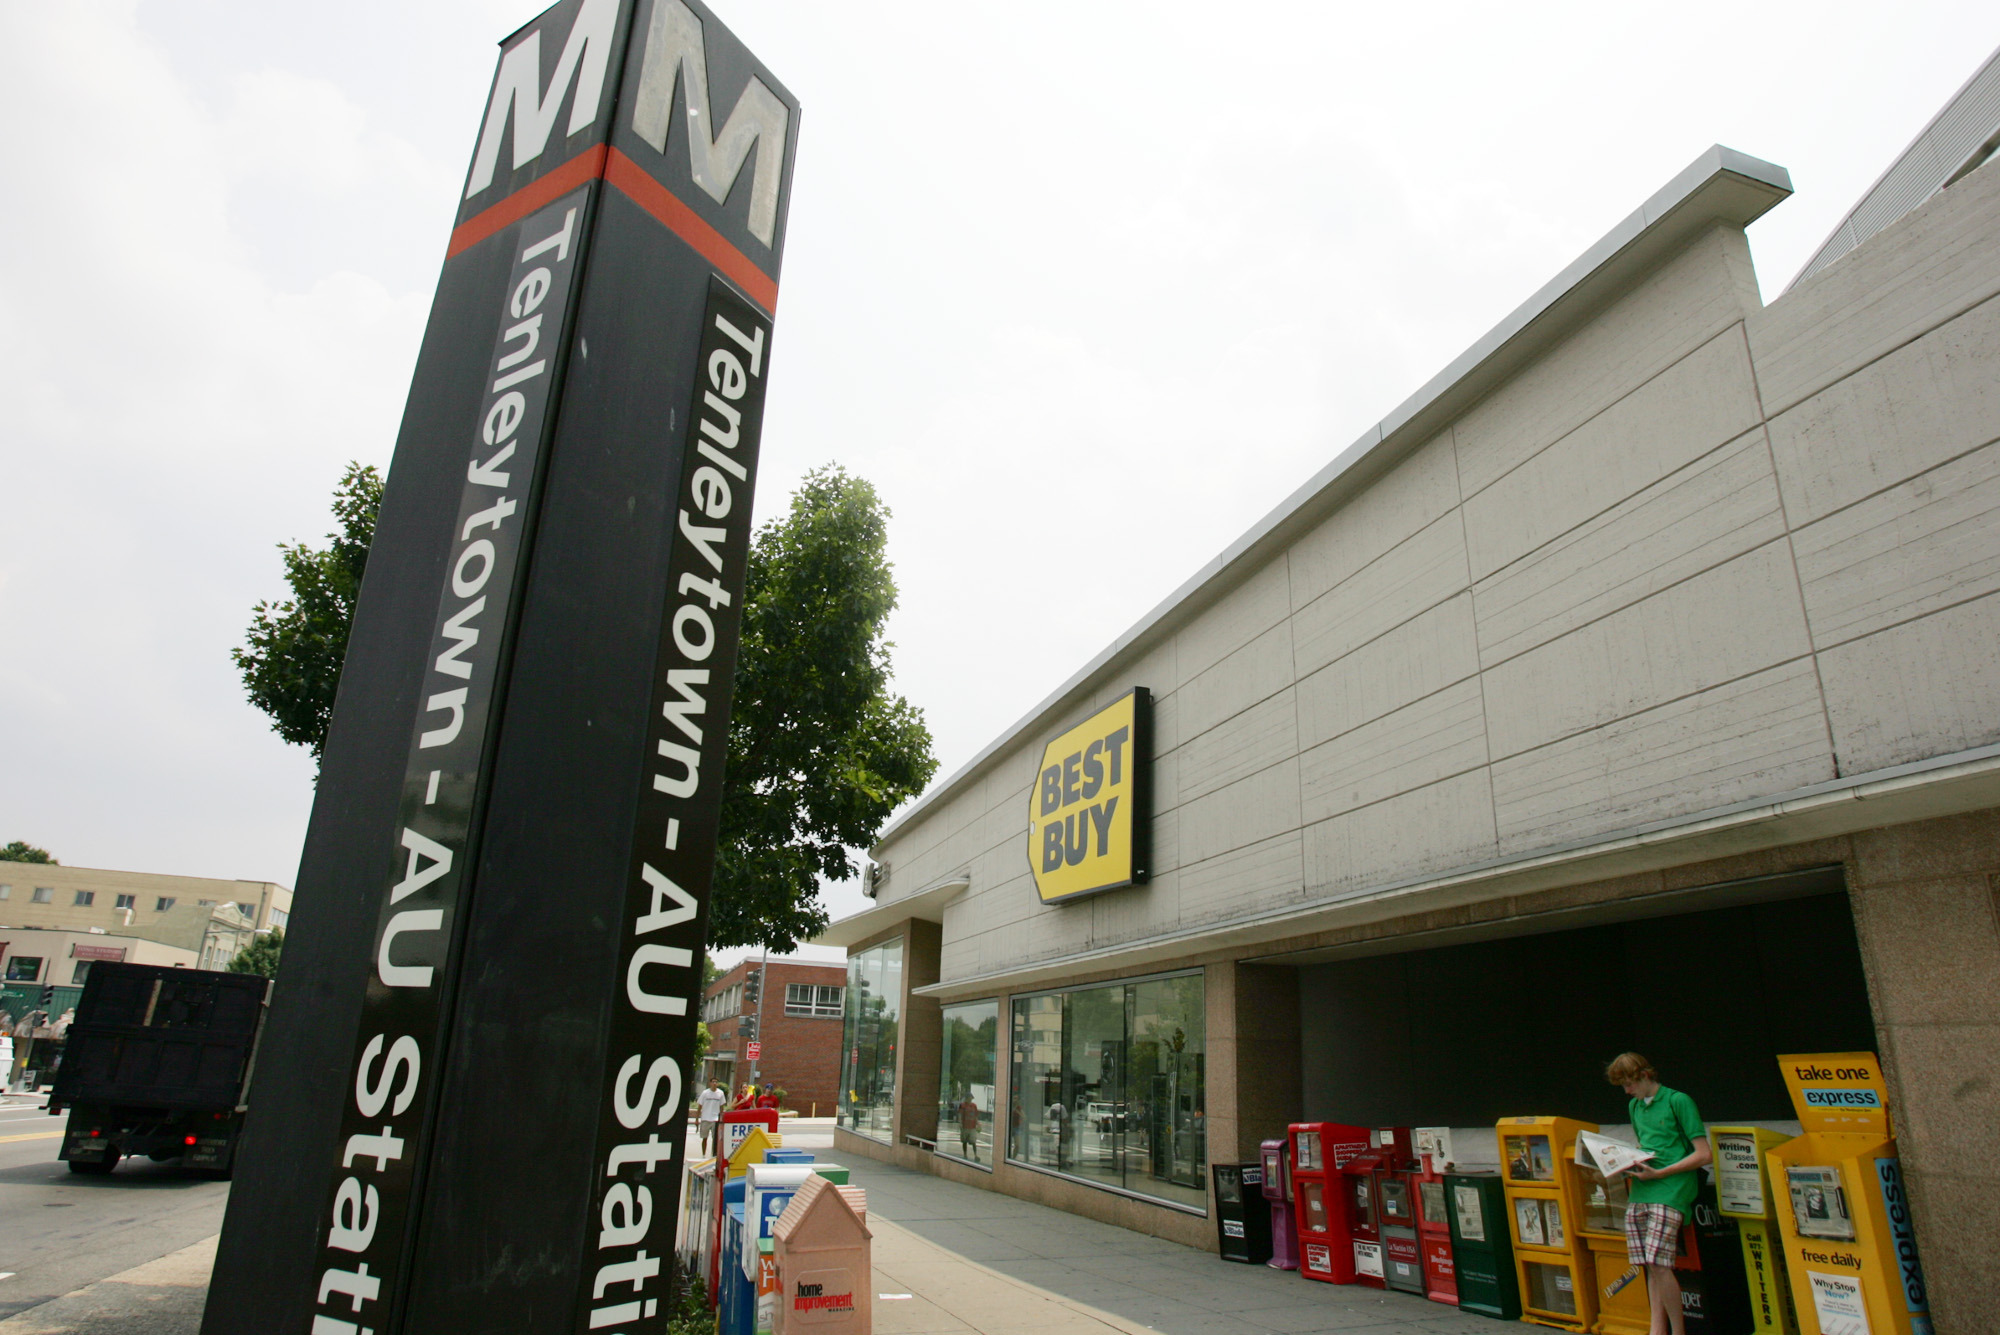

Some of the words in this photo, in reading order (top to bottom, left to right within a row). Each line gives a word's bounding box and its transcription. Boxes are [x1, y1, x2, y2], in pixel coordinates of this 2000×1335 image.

[466, 0, 621, 200] M
[632, 0, 790, 251] M
[419, 207, 578, 750] Tenleytown
[653, 314, 765, 799] Tenleytown
[1041, 725, 1129, 817] BEST
[1042, 796, 1120, 874] BUY
[1795, 1065, 1833, 1081] take
[1836, 1067, 1870, 1080] one
[1806, 1092, 1876, 1106] express
[1718, 1142, 1751, 1153] Writing
[1725, 1152, 1756, 1162] Classes
[1736, 1162, 1759, 1170] .com
[589, 1054, 682, 1335] Stati
[1746, 1233, 1762, 1242] Call
[1881, 1164, 1924, 1305] express
[1801, 1248, 1829, 1263] free
[1831, 1252, 1862, 1270] daily
[797, 1281, 823, 1297] home
[1813, 1278, 1833, 1290] Why
[1834, 1281, 1856, 1293] Stop
[794, 1291, 853, 1314] improvement
